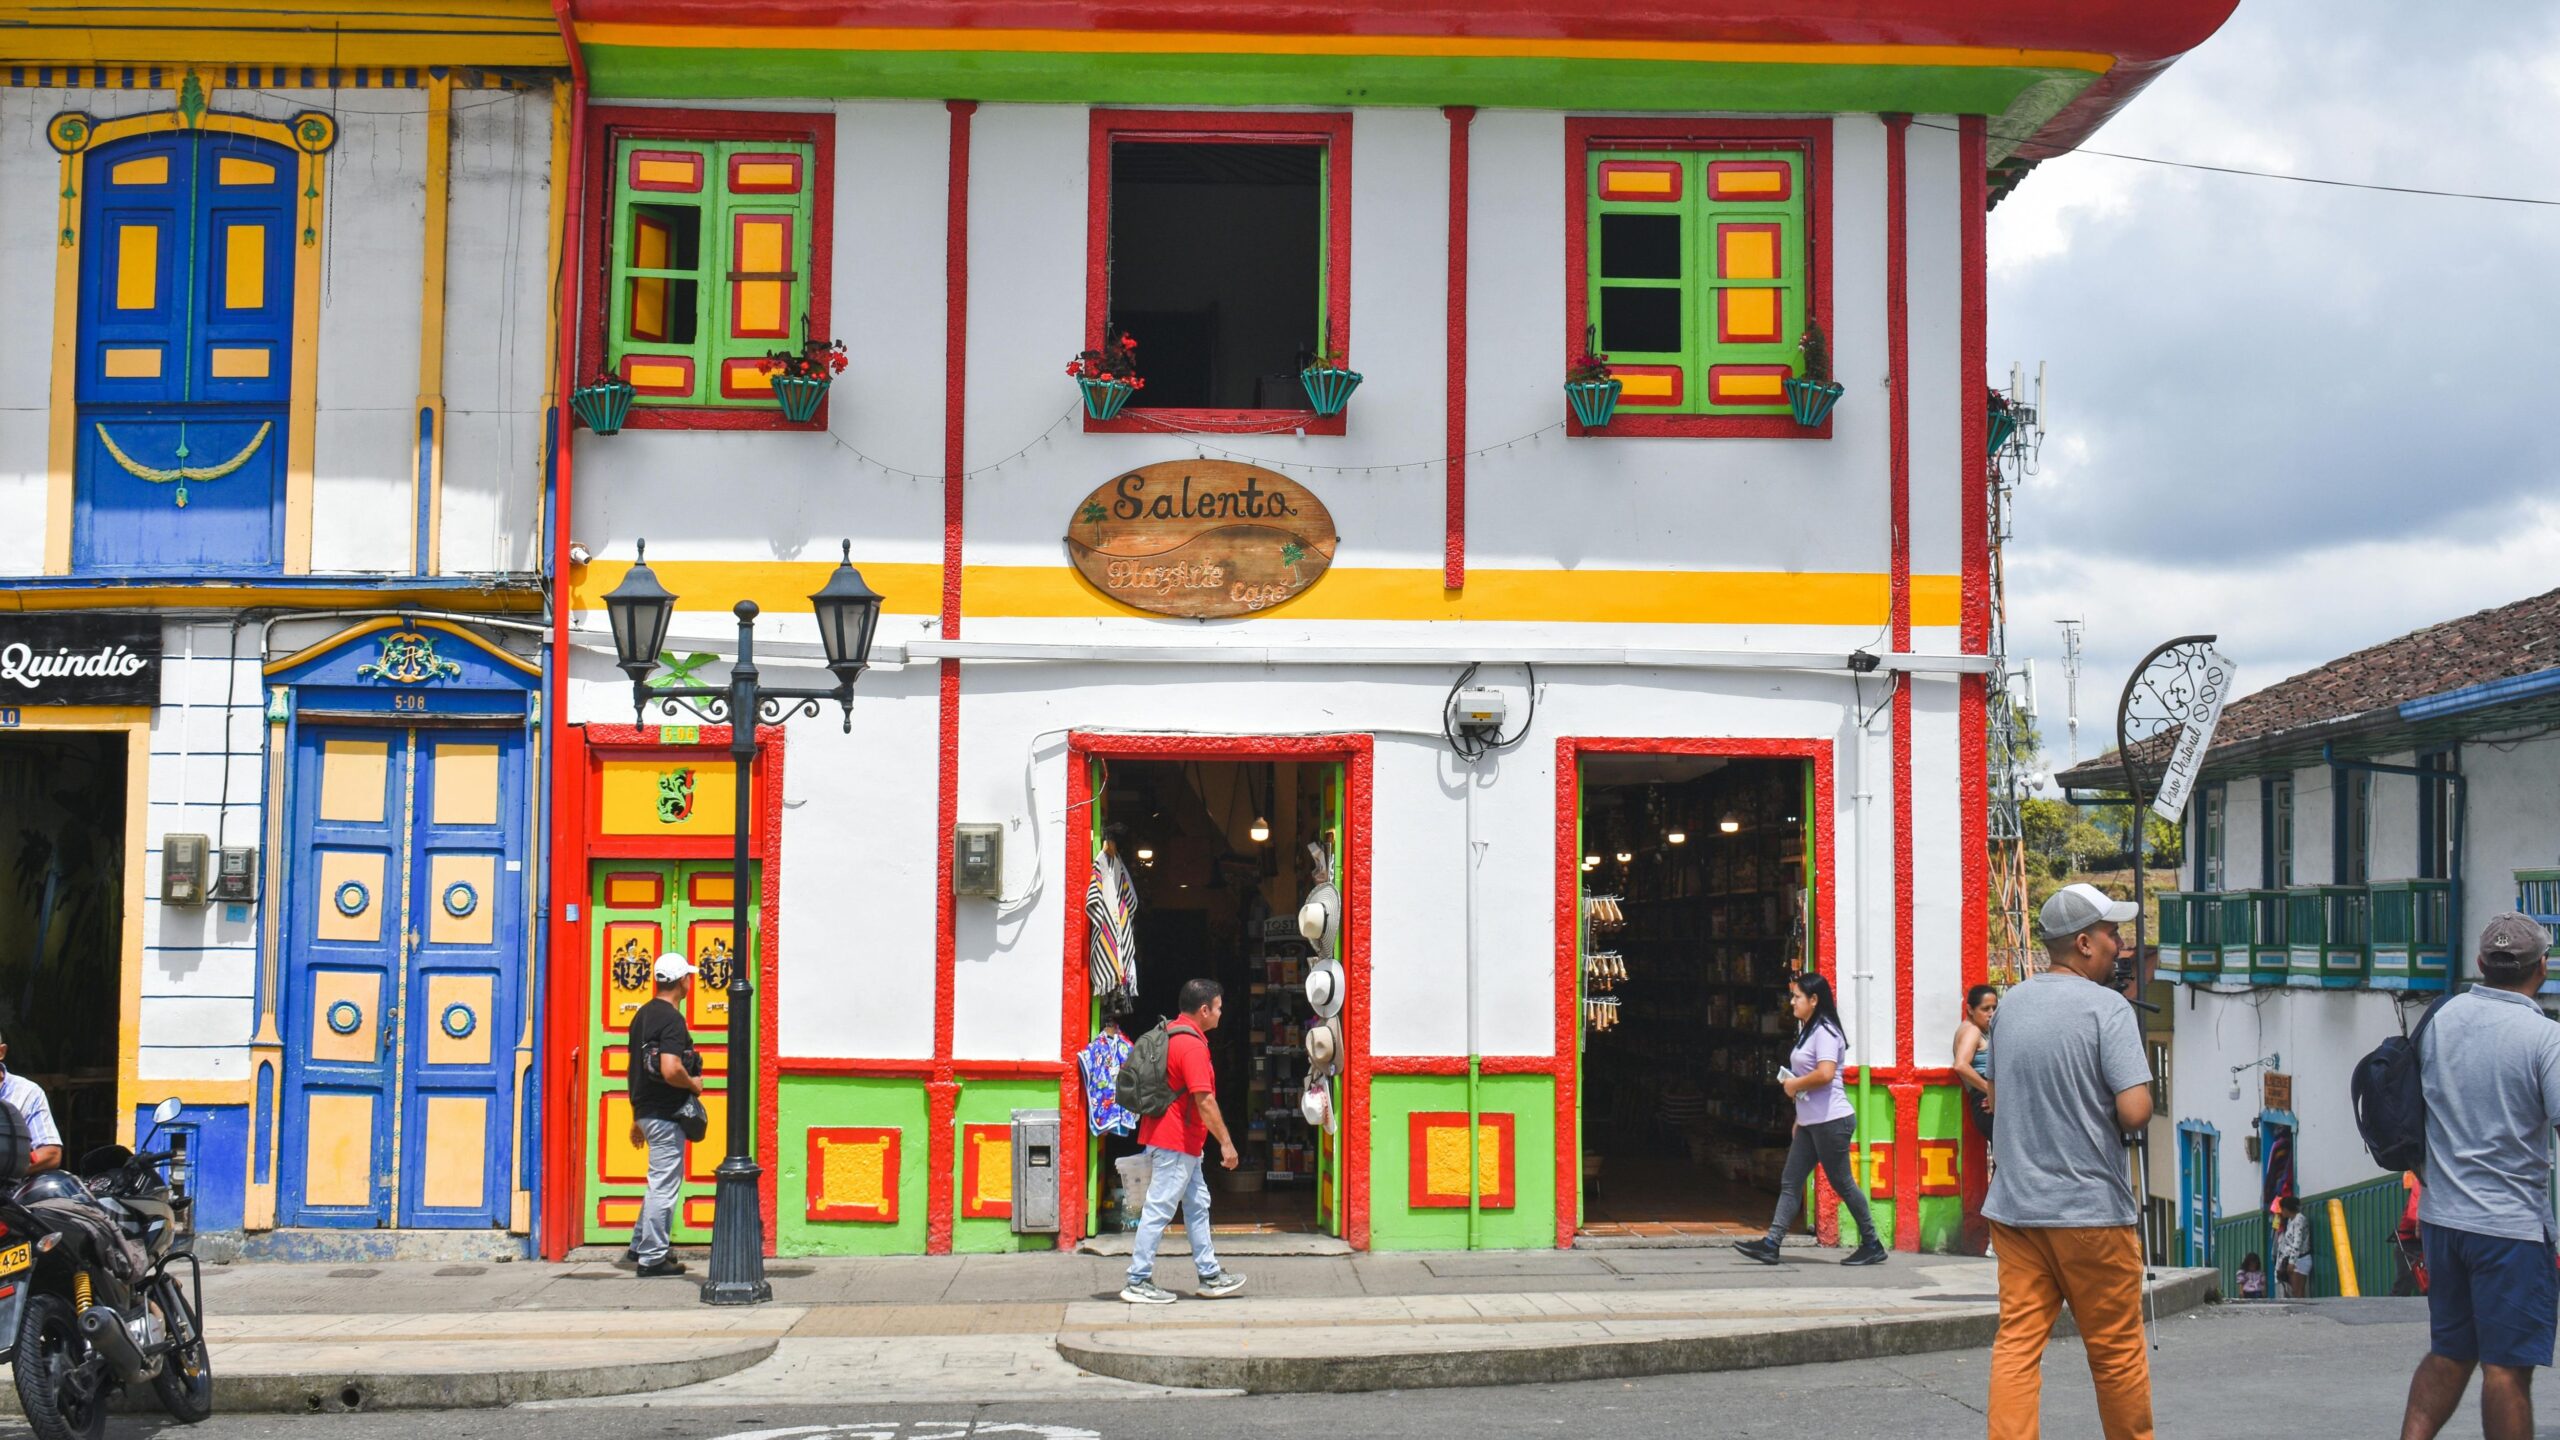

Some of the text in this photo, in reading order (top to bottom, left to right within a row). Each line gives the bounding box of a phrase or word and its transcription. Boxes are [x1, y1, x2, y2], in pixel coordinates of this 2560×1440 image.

[1113, 474, 1298, 520] Salento
[1, 642, 149, 689] Quindío
[395, 694, 425, 709] 5-08
[664, 726, 695, 741] 5-06
[2159, 725, 2202, 808] Paso Peatonal
[2, 1248, 28, 1268] 42B
